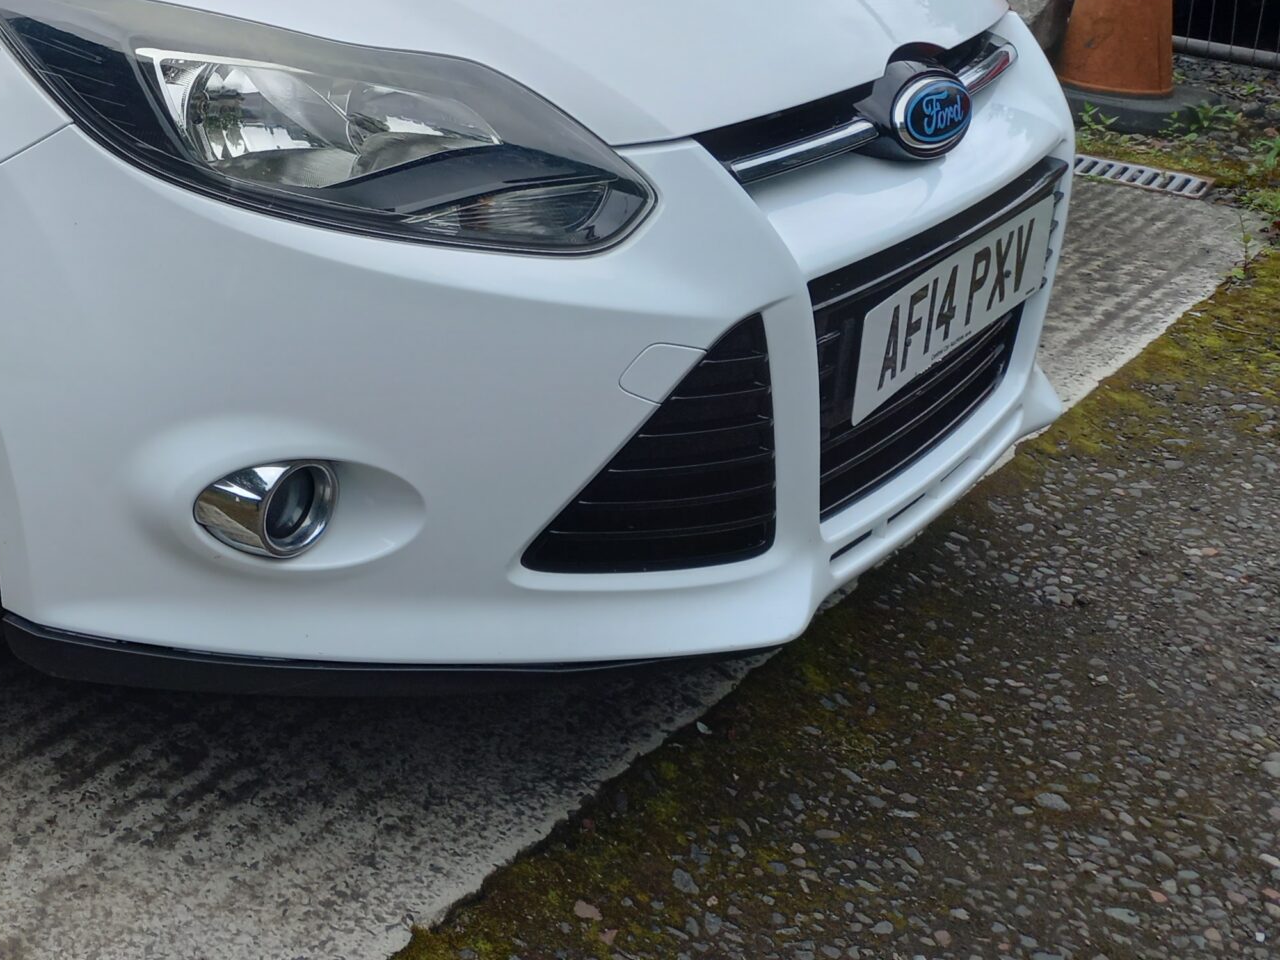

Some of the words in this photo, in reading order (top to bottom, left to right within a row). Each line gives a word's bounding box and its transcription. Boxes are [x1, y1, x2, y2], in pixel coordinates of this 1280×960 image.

[923, 91, 963, 136] Ford
[878, 265, 959, 392] AF14
[964, 218, 1036, 327] PXV
